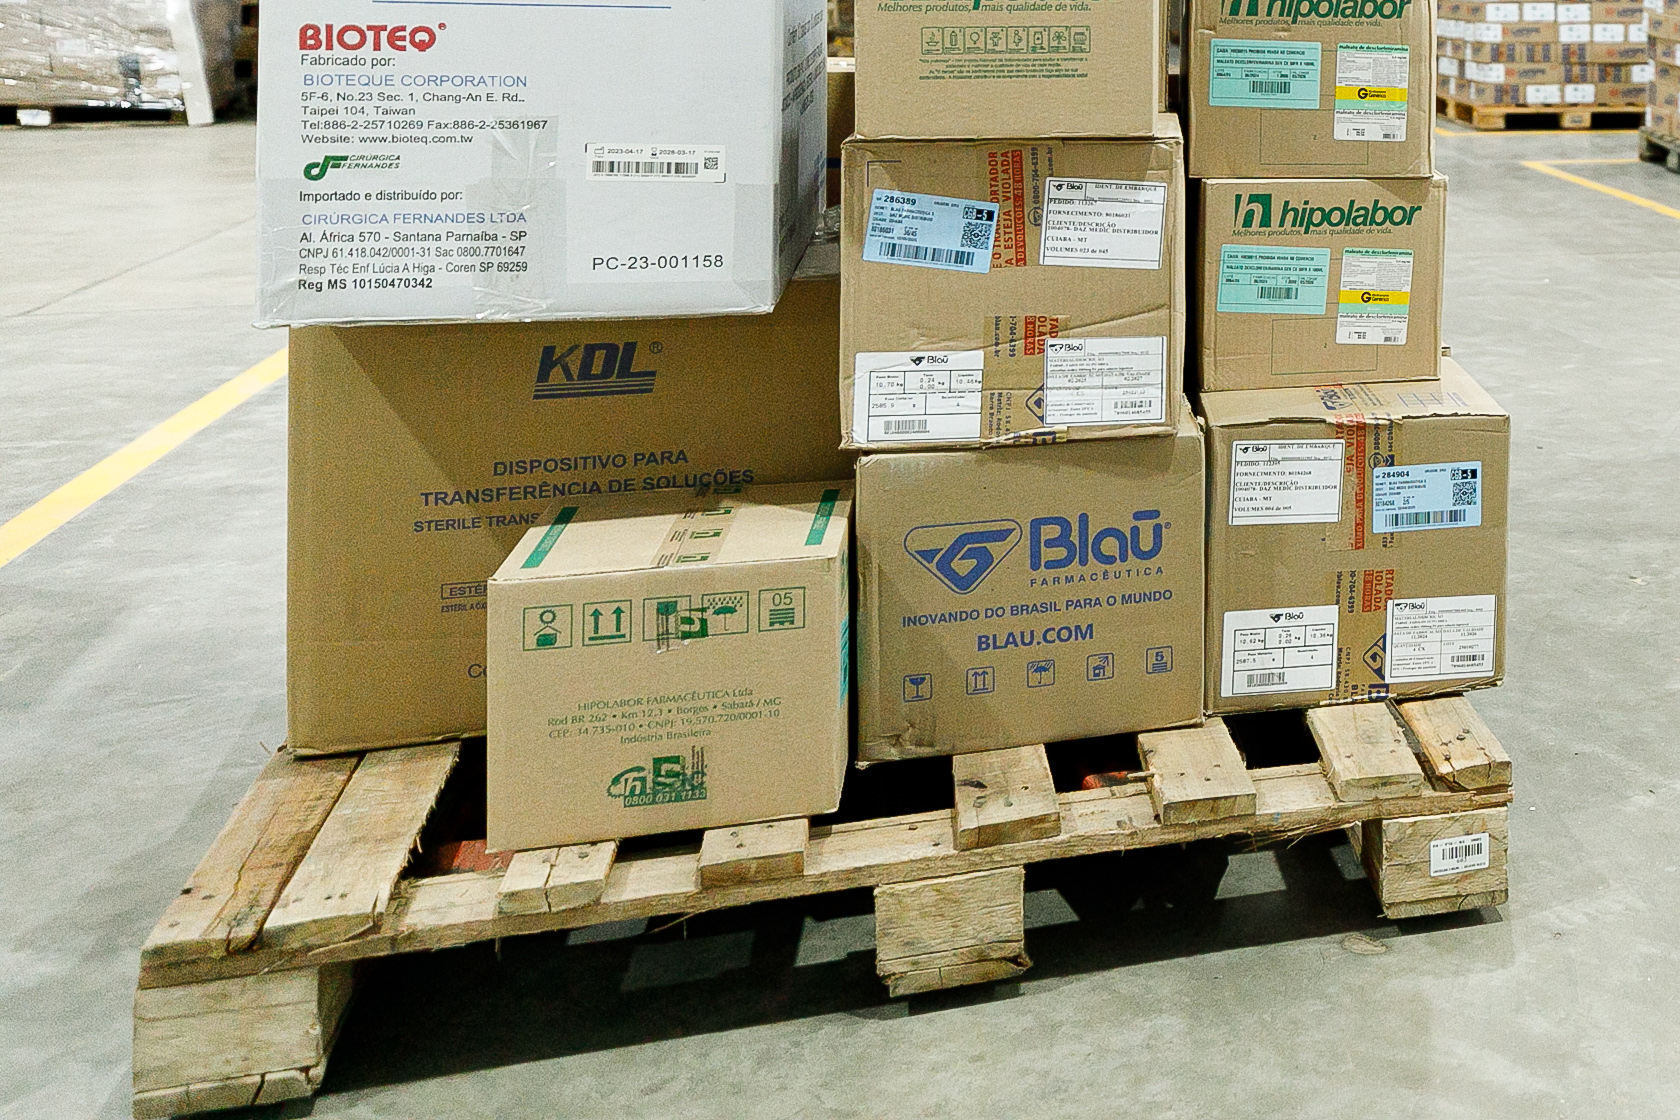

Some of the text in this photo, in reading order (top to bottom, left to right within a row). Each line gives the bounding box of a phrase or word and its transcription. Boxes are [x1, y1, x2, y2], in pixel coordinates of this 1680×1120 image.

[878, 2, 1091, 14] Melhores produtos, mais qualidade de vida.
[301, 54, 396, 69] Fabricado por:
[304, 74, 527, 88] BIOTEQUE CORPORATION
[301, 92, 332, 103] 5F-6,
[336, 92, 373, 102] No.23
[377, 92, 404, 102] Sec.
[409, 93, 418, 103] 1,
[423, 92, 482, 104] Chang-An
[486, 93, 498, 102] E.
[301, 106, 416, 117] Taipei 104, Taiwan
[301, 120, 548, 130] Tel:886-2-25710269 Fax:886-2-25361967
[301, 134, 472, 146] Website: www.bioteq.com.tw
[350, 153, 400, 161] CIRÚRGICA
[300, 190, 463, 203] Importado e distribuído por:
[884, 195, 916, 205] 286389
[302, 211, 526, 225] CIRÚRGICA FERNANDES LTDA
[1278, 200, 1422, 234] hipolabor
[300, 232, 315, 243] Al.
[320, 229, 354, 242] África
[359, 231, 381, 242] 570
[393, 231, 442, 242] Santana
[510, 231, 527, 241] SP
[299, 246, 525, 258] CNPJ 61.418.042/0001-31 Sac 0800.7701647
[299, 262, 527, 275] Resp Téc Enf Lúcia A Higa Coren SP 69259
[592, 254, 723, 270] PC-23-001158
[298, 278, 433, 292] Reg MS 10150470342
[535, 342, 657, 381] KDL
[493, 450, 688, 476] DISPOSITIVO PARA
[421, 480, 601, 507] TRANSFERÊNCIA
[609, 478, 636, 493] DE
[414, 517, 481, 533] STERILE
[1030, 567, 1164, 587] FARMACÊUTICA
[772, 591, 793, 607] 05
[902, 590, 1173, 627] INOVANDO DO BRASIL PARA O MUNDO
[977, 623, 1095, 651] BLAU.COM
[1155, 652, 1164, 662] 5
[578, 687, 753, 711] HIPOLABOR FARMACÊUTICA Ltda
[571, 715, 585, 724] BR
[621, 710, 638, 719] Km
[763, 697, 781, 707] MG
[620, 729, 711, 744] Indústria Brasileira
[625, 795, 652, 806] 0800
